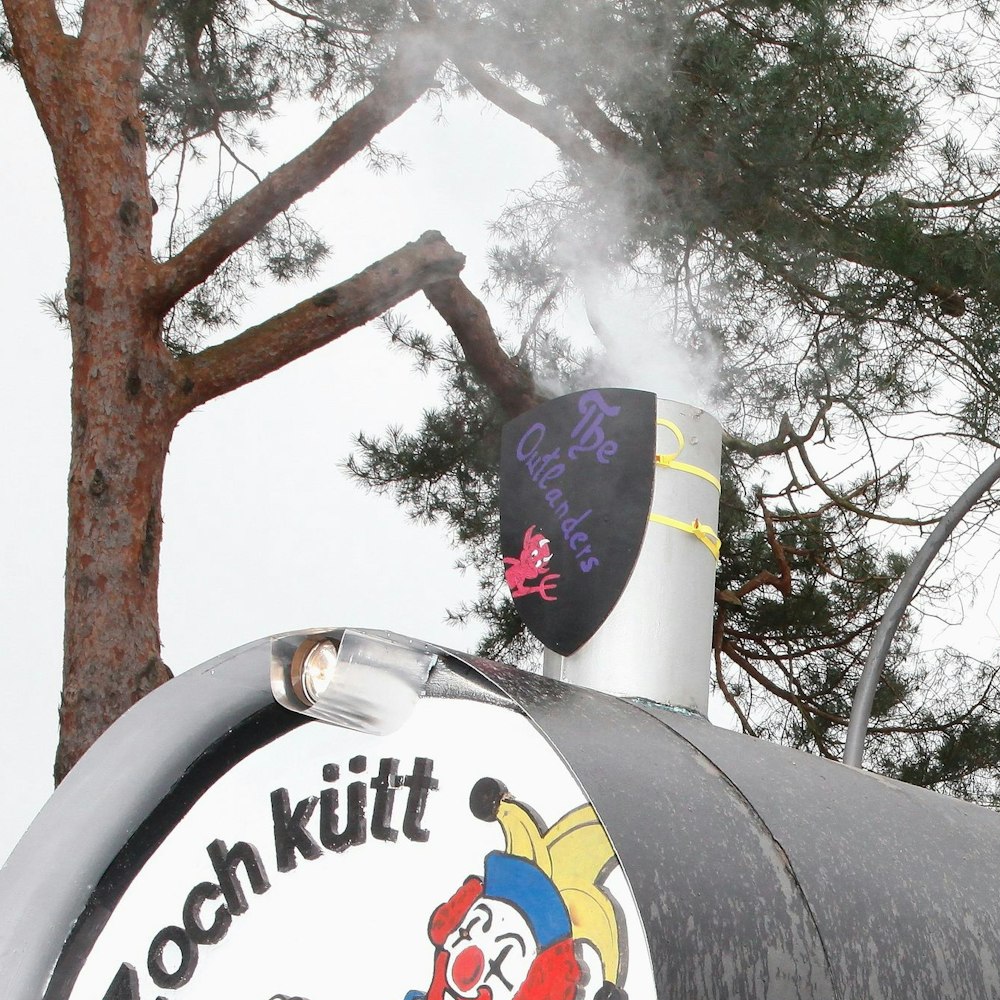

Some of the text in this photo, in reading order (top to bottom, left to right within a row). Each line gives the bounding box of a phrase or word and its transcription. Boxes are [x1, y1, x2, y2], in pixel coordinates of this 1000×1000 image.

[568, 390, 621, 464] The
[516, 422, 599, 573] Outlanders
[270, 755, 439, 873] kütt
